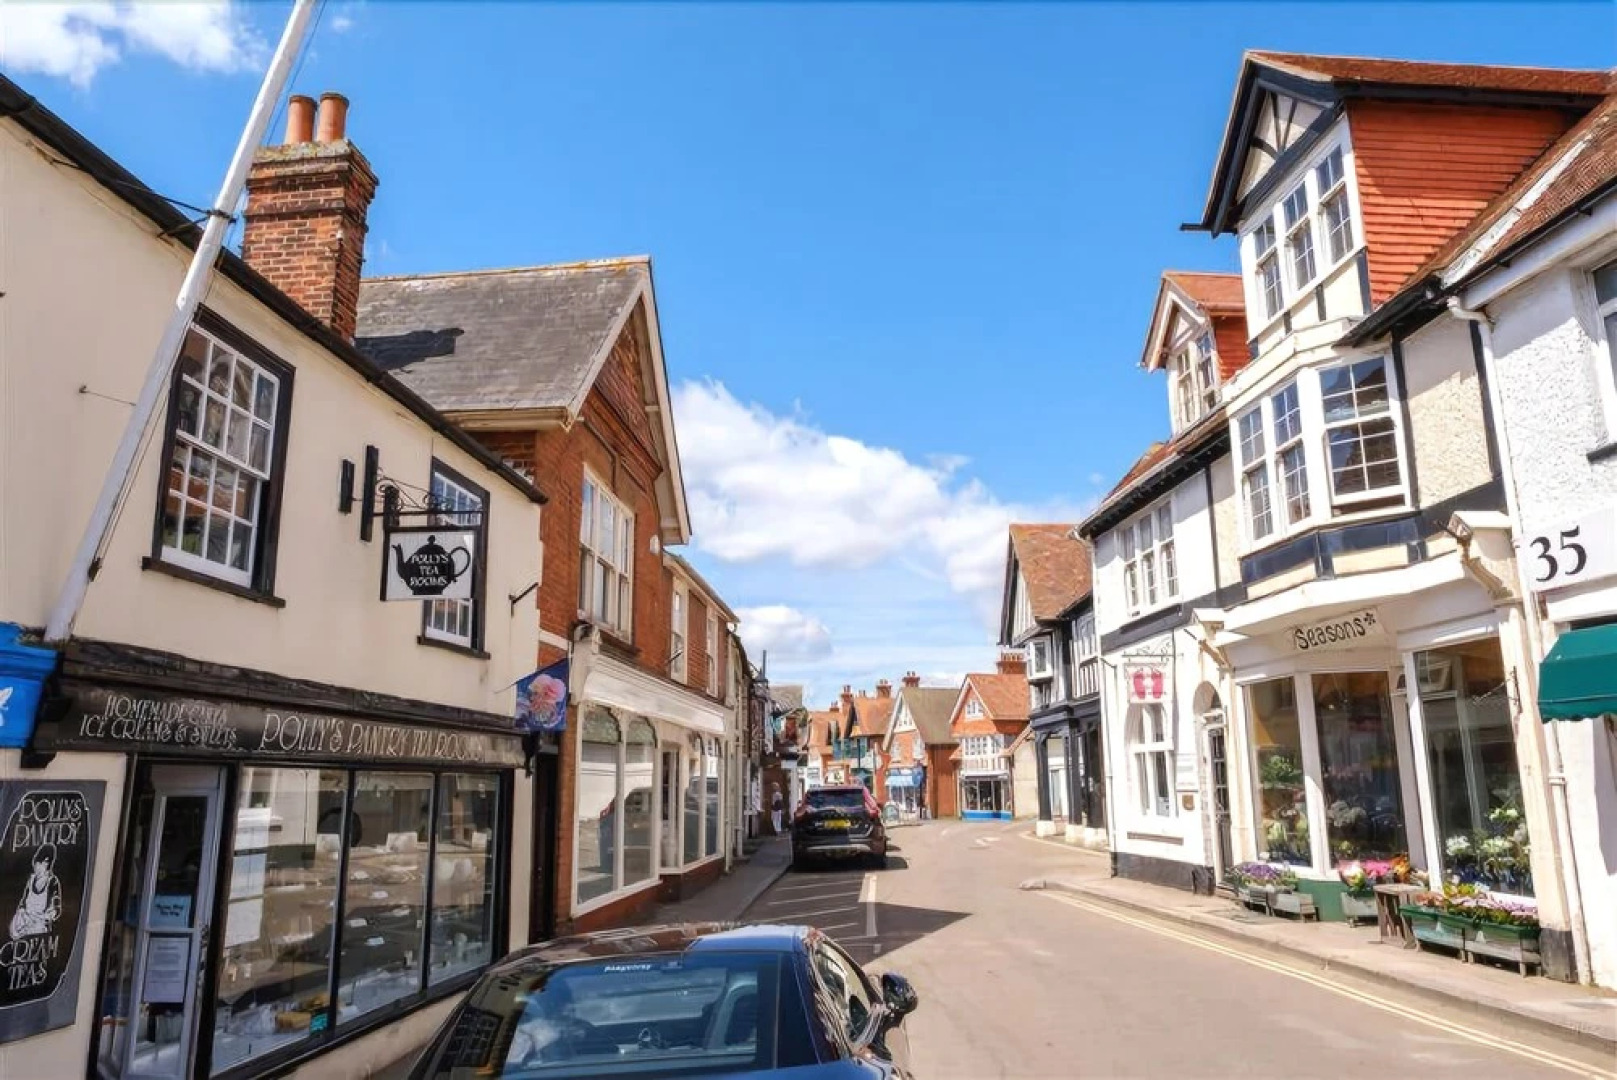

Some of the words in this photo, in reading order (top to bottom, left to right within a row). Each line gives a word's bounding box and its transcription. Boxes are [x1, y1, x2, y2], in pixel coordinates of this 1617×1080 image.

[1530, 525, 1588, 583] 35
[420, 565, 439, 575] TEA
[1294, 617, 1366, 649] Seasons
[79, 714, 107, 738] ICE
[259, 713, 345, 753] POLLY'S
[347, 722, 409, 757] PANTRY
[411, 728, 436, 758] TEA
[12, 822, 82, 853] PANTRY
[0, 935, 59, 967] CREAM
[7, 962, 48, 990] TEAS
